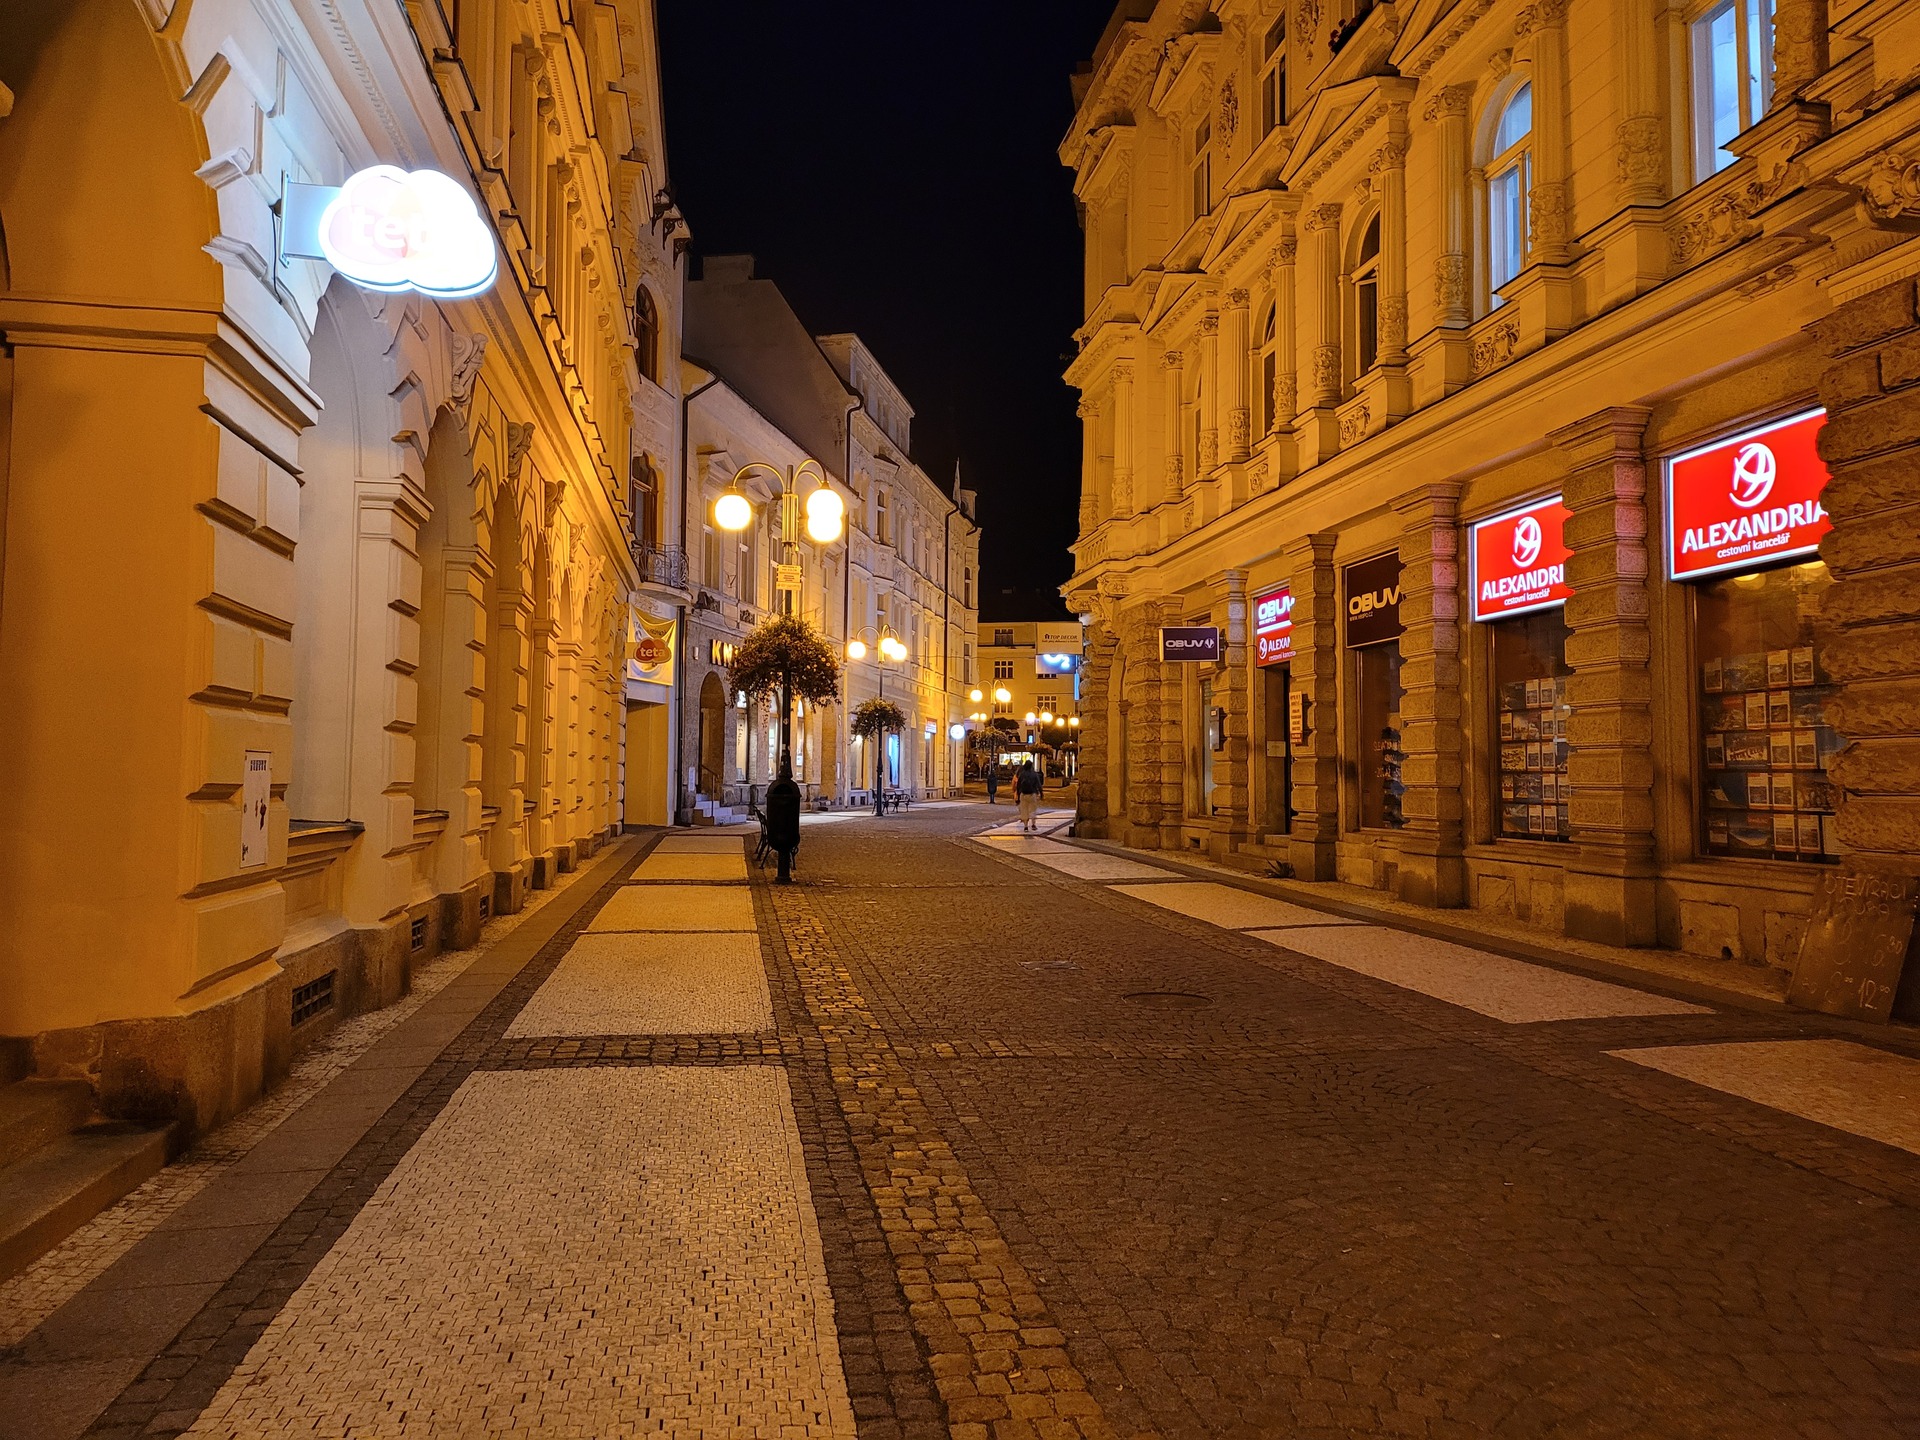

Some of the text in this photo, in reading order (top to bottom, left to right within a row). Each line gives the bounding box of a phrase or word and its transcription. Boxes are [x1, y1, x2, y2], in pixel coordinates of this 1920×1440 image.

[1717, 532, 1791, 559] cestovní kancelář
[1481, 563, 1564, 601] ALEXANDRI
[1349, 585, 1400, 615] OBUV
[1504, 587, 1551, 606] cestovní kancelář
[640, 647, 666, 657] teta
[1165, 639, 1204, 648] OBUV
